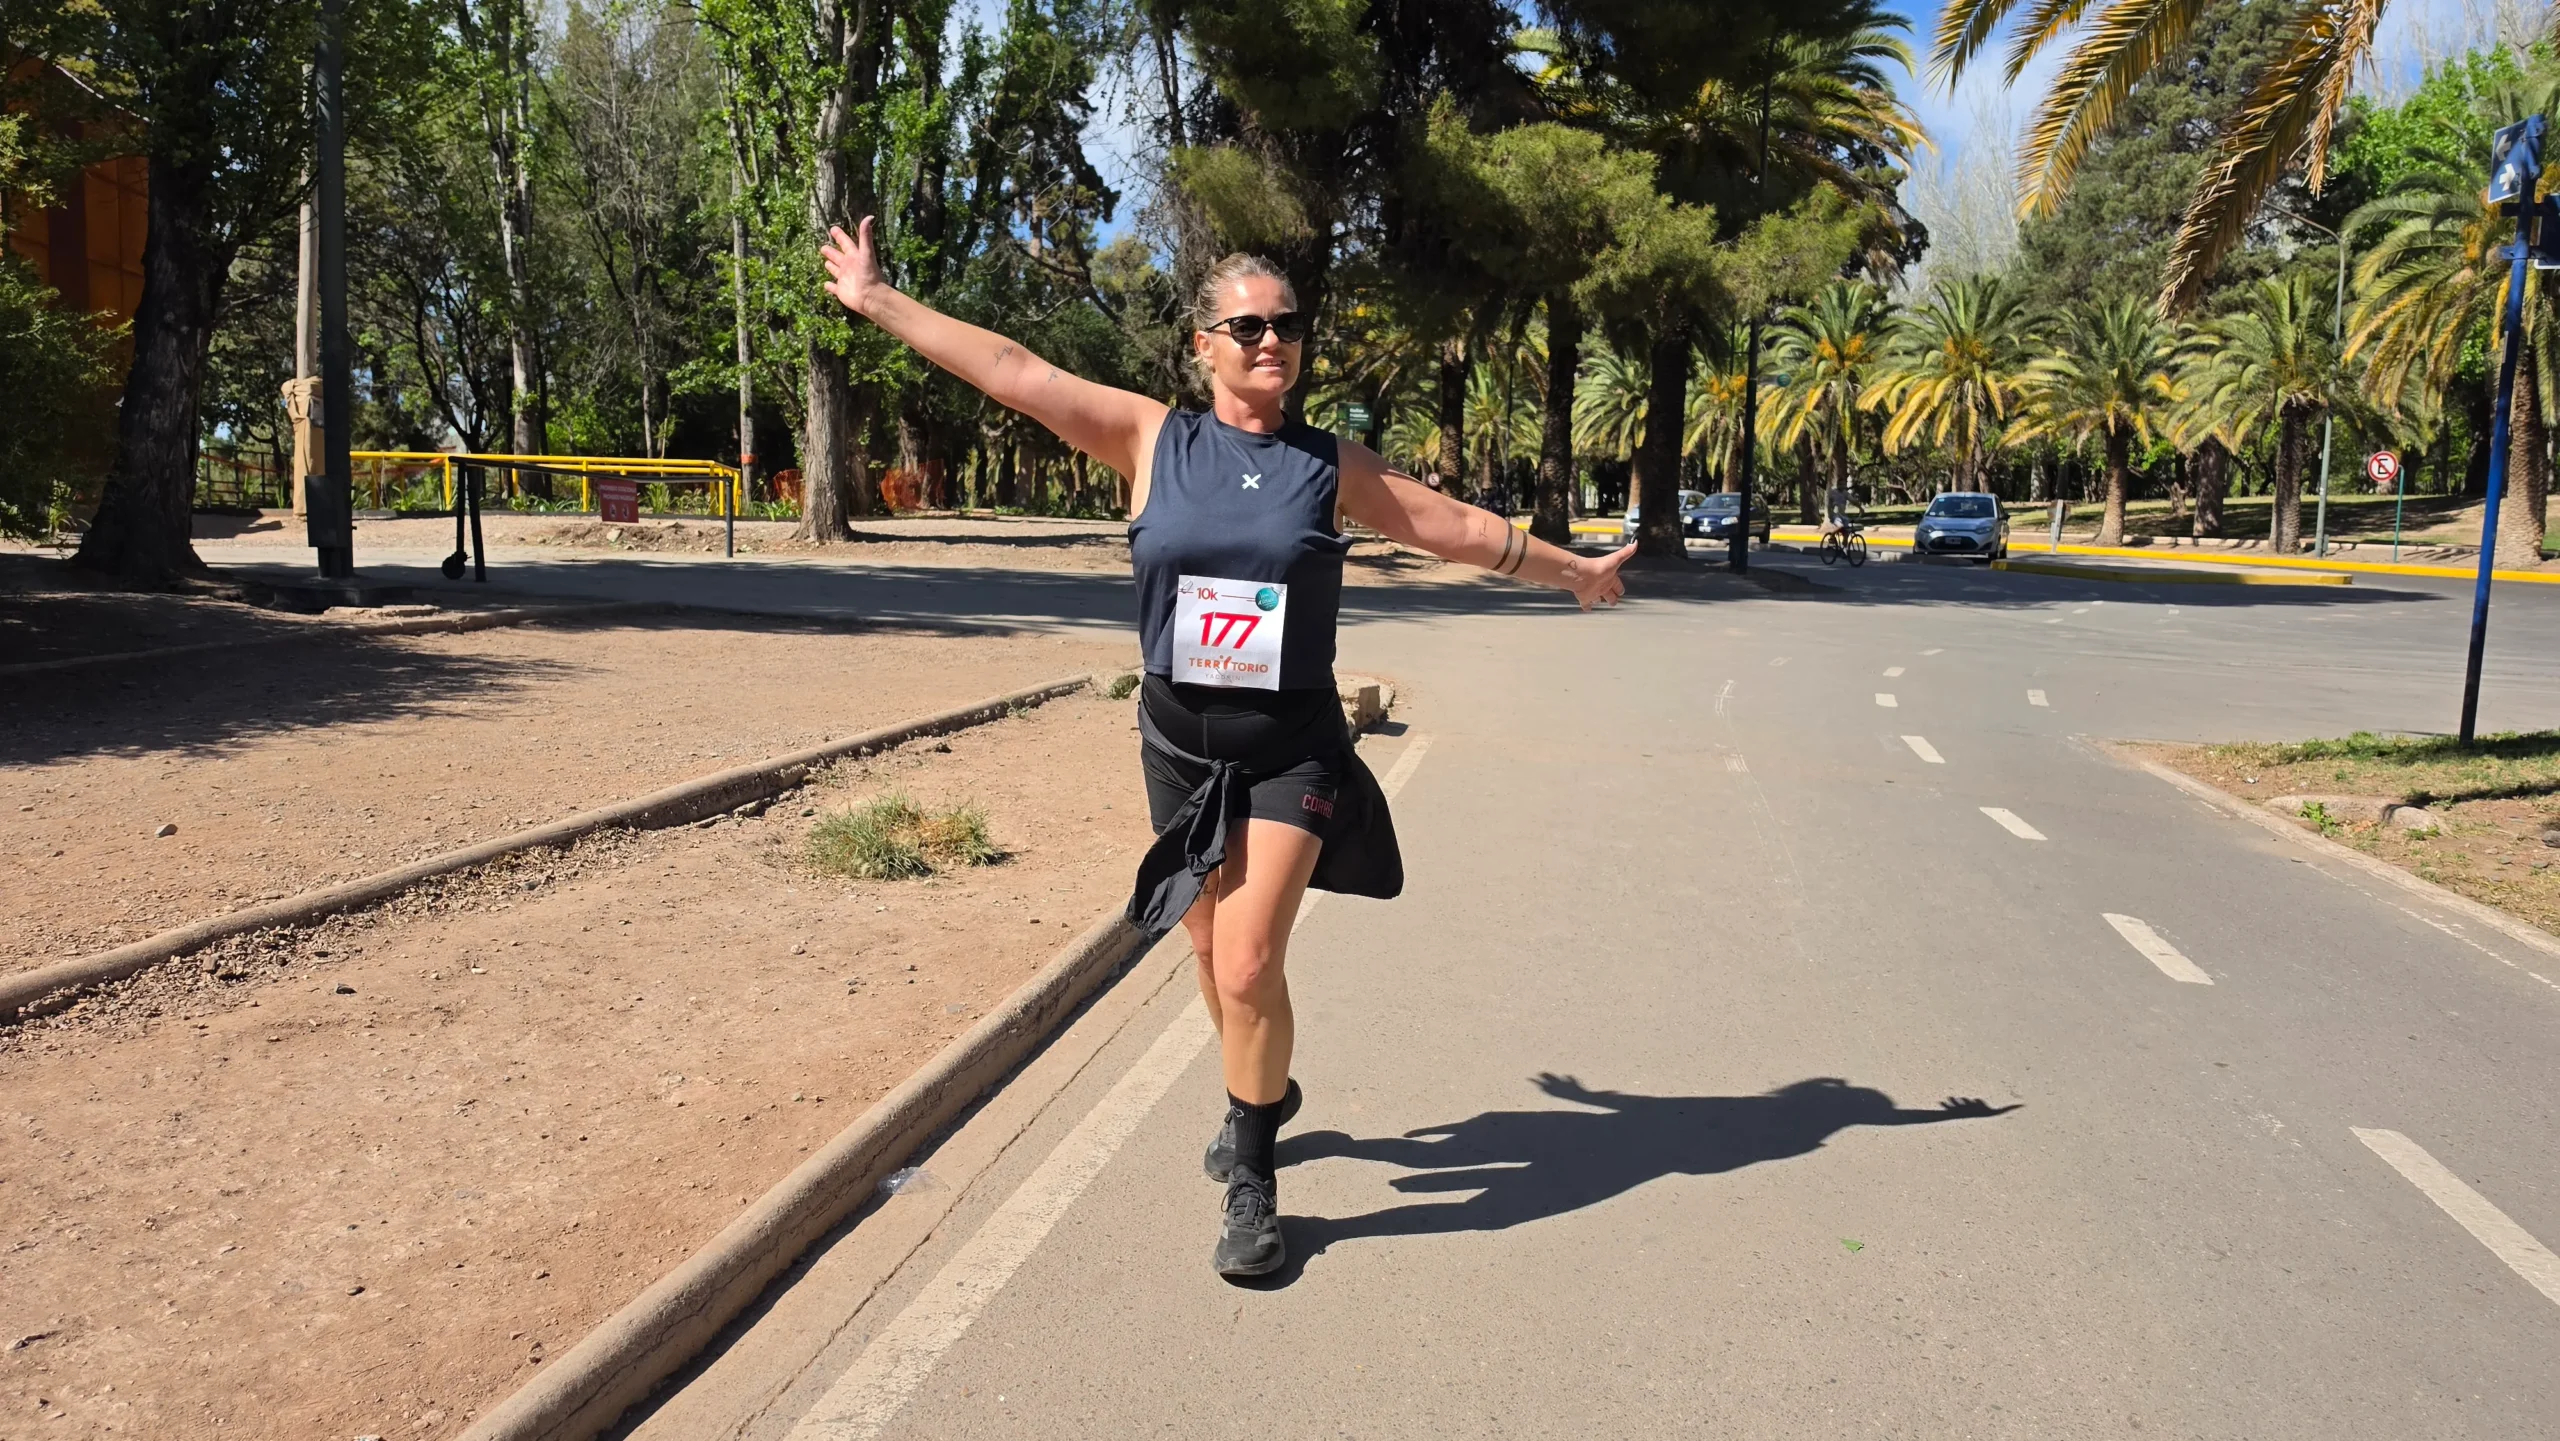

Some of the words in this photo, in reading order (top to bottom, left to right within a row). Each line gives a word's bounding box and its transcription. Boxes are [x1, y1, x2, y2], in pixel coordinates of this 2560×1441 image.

[1196, 587, 1218, 601] 10k
[1200, 611, 1262, 649] 177
[1188, 655, 1269, 673] TERRITORIO
